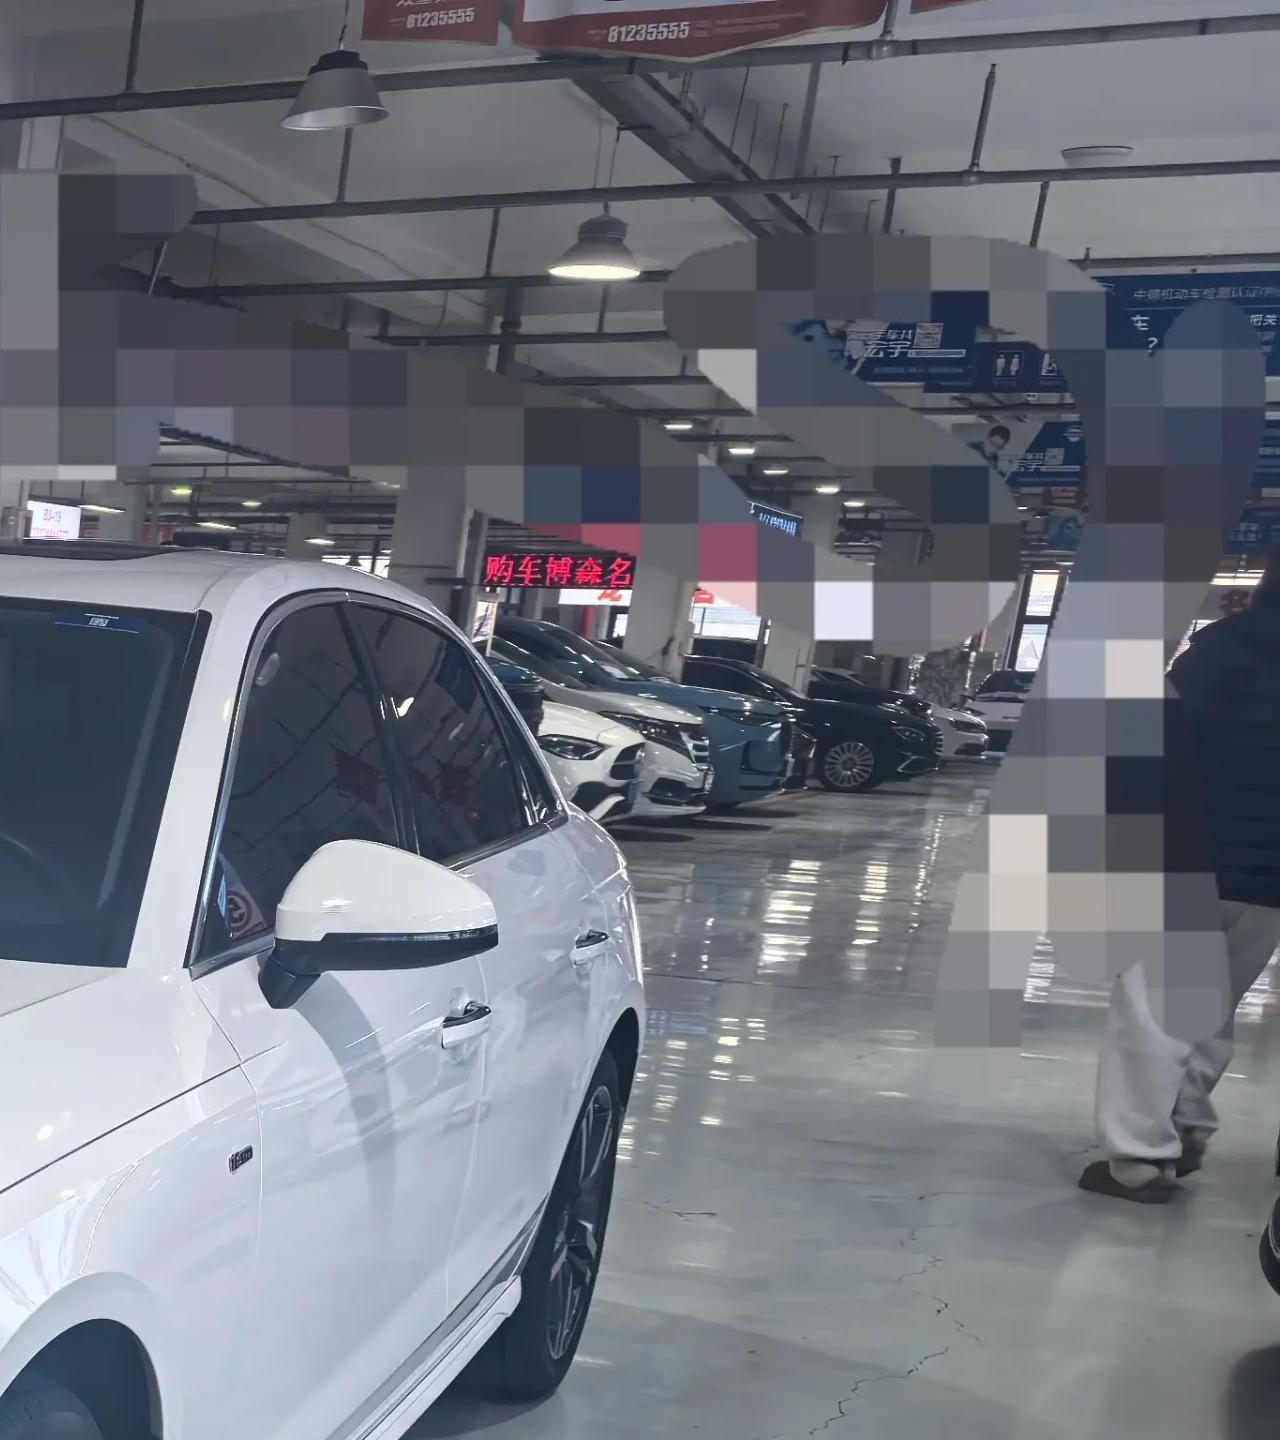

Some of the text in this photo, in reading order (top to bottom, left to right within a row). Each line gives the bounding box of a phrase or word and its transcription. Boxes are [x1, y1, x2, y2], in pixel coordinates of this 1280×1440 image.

[406, 7, 475, 29] 81235555
[608, 21, 690, 43] 81235555
[484, 555, 632, 587] 购车博森名
